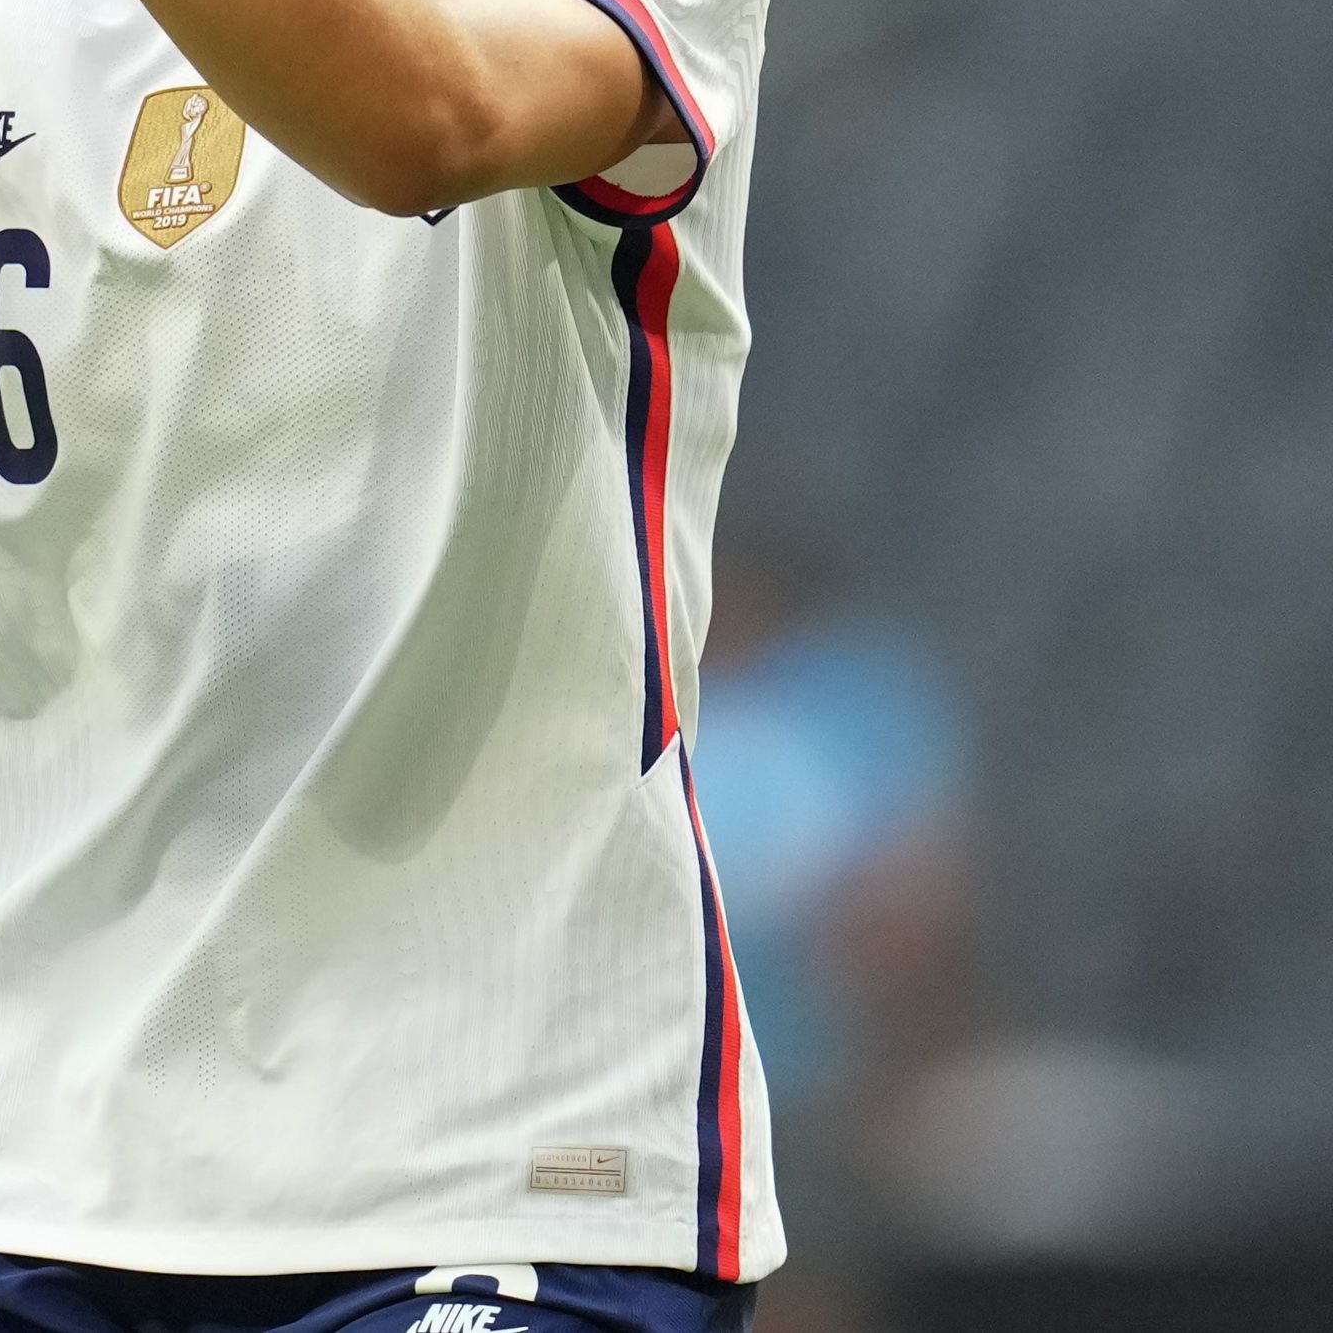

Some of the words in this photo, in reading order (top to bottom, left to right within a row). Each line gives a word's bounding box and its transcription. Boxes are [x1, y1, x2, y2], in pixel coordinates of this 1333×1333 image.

[147, 184, 202, 209] FIFA
[132, 209, 163, 220] WORLD
[163, 204, 215, 216] CHAMPIONS
[153, 215, 188, 229] 2019
[418, 1303, 502, 1333] NIKE
